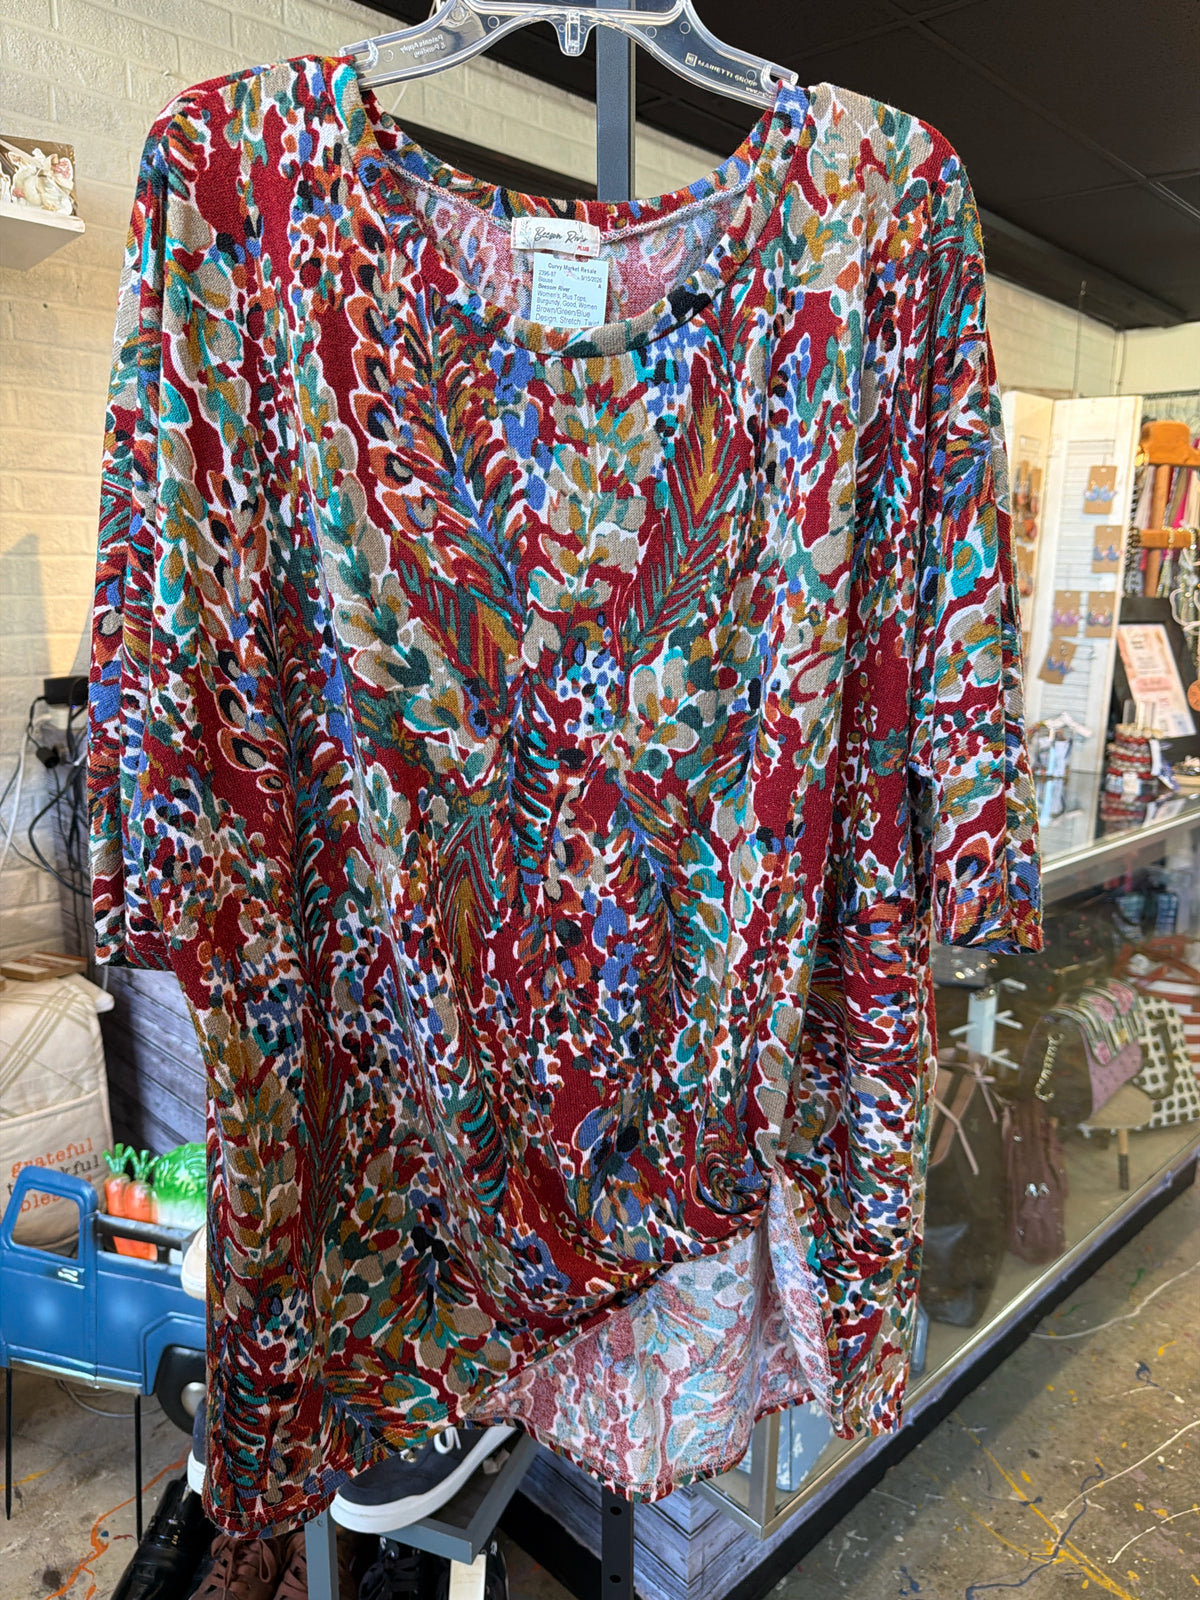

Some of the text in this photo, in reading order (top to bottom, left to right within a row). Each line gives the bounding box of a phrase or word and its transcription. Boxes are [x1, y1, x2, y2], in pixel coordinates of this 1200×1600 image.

[563, 264, 580, 272] Market
[562, 293, 573, 301] Plus
[11, 1136, 94, 1179] grateful
